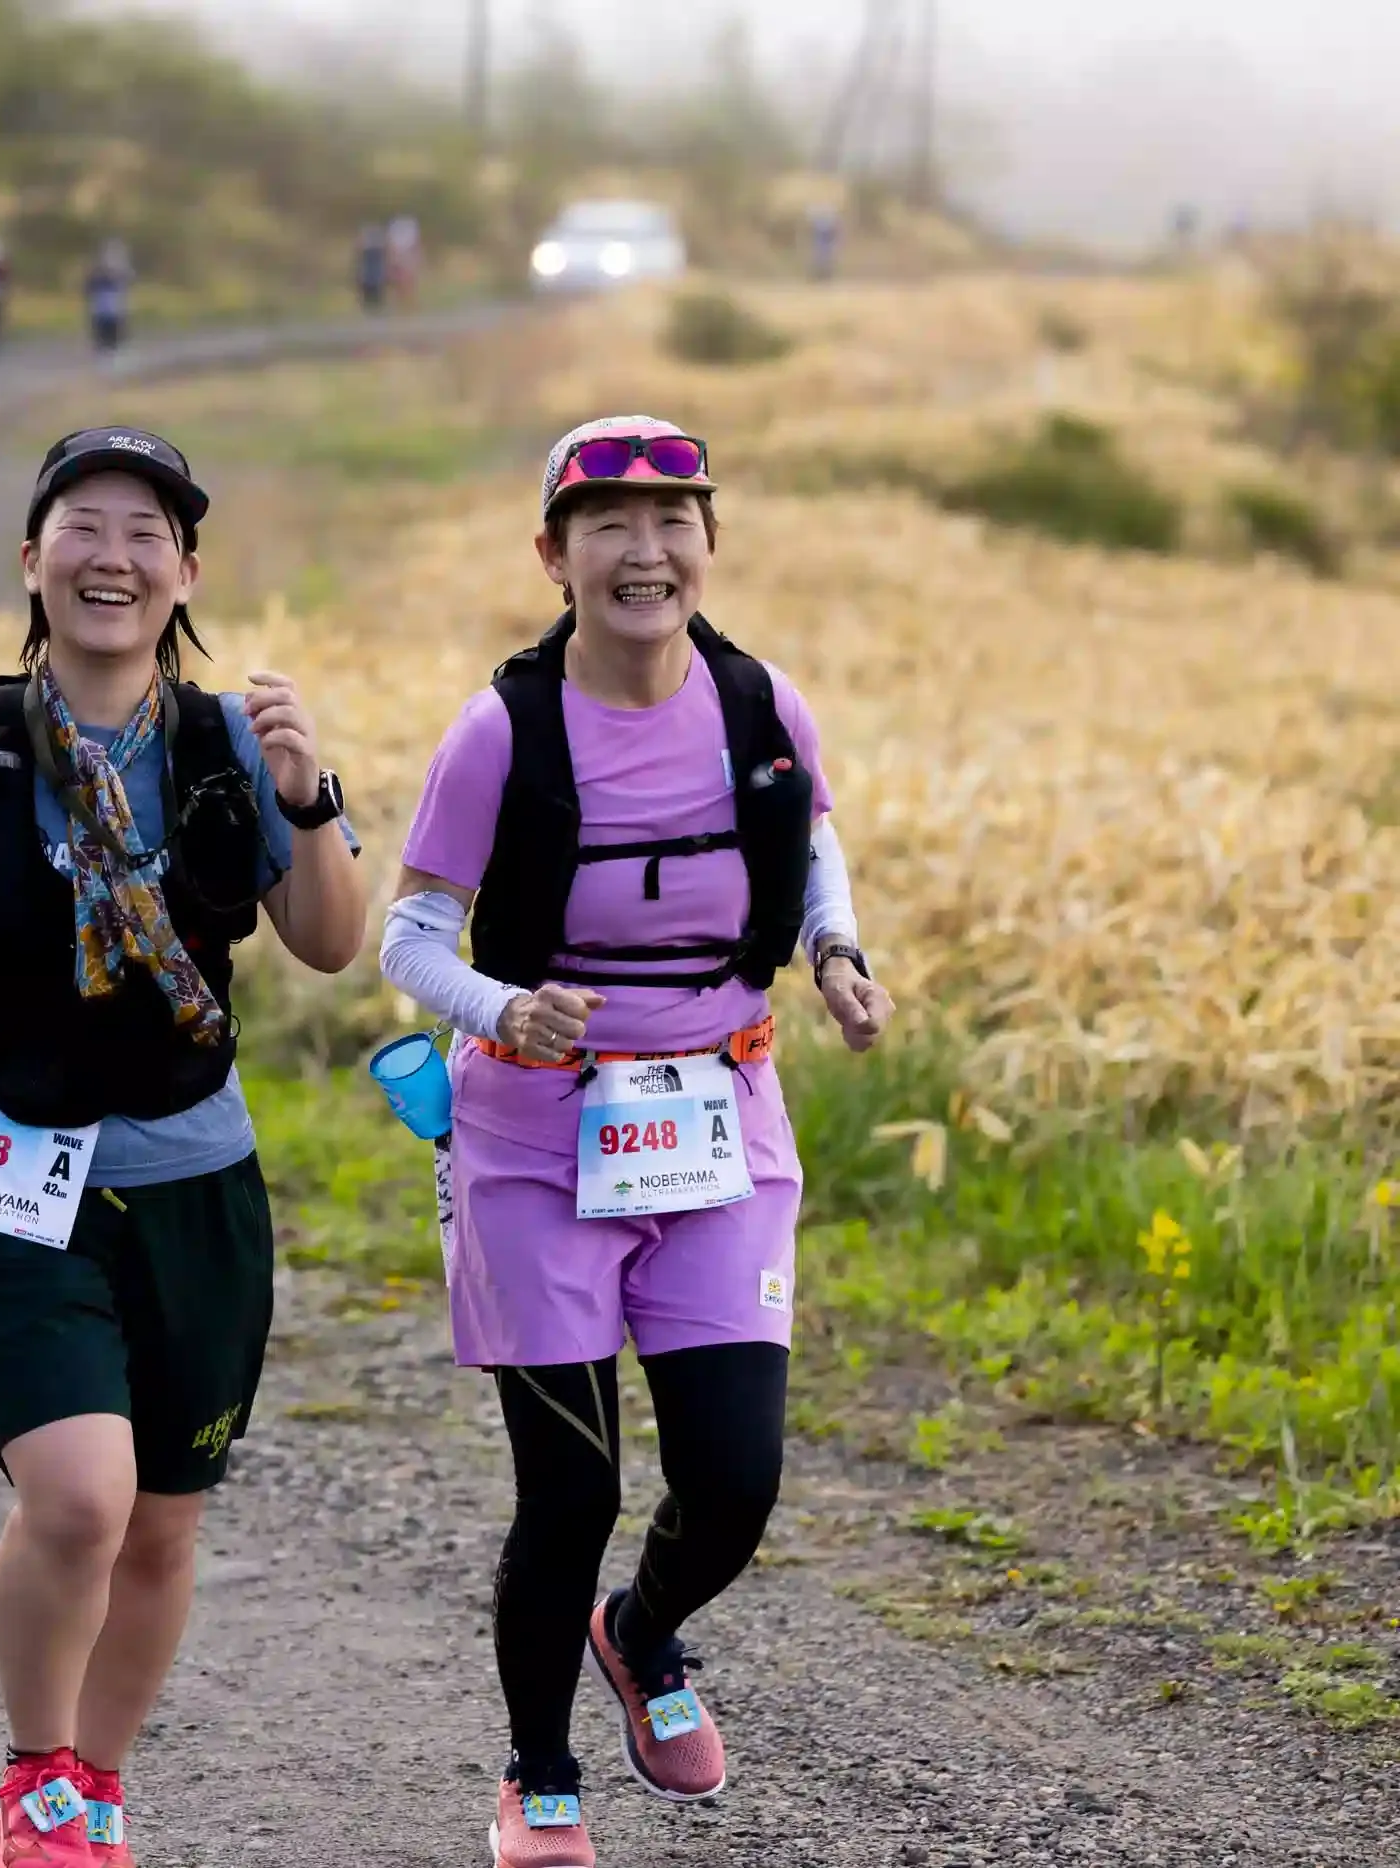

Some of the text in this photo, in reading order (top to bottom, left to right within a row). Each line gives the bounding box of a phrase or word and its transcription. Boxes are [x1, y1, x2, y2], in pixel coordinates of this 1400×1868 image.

[108, 436, 156, 451] ARE YOU
[111, 442, 151, 455] GONNA
[647, 1065, 665, 1074] THE
[629, 1074, 664, 1085] NORTH
[640, 1084, 665, 1095] FACE
[703, 1099, 728, 1111] WAVE
[711, 1115, 728, 1142] A
[53, 1132, 85, 1151] WAVE
[599, 1120, 678, 1156] 9248
[48, 1151, 70, 1181] A
[640, 1170, 718, 1189] NOBEYAMA
[42, 1181, 68, 1199] 42km
